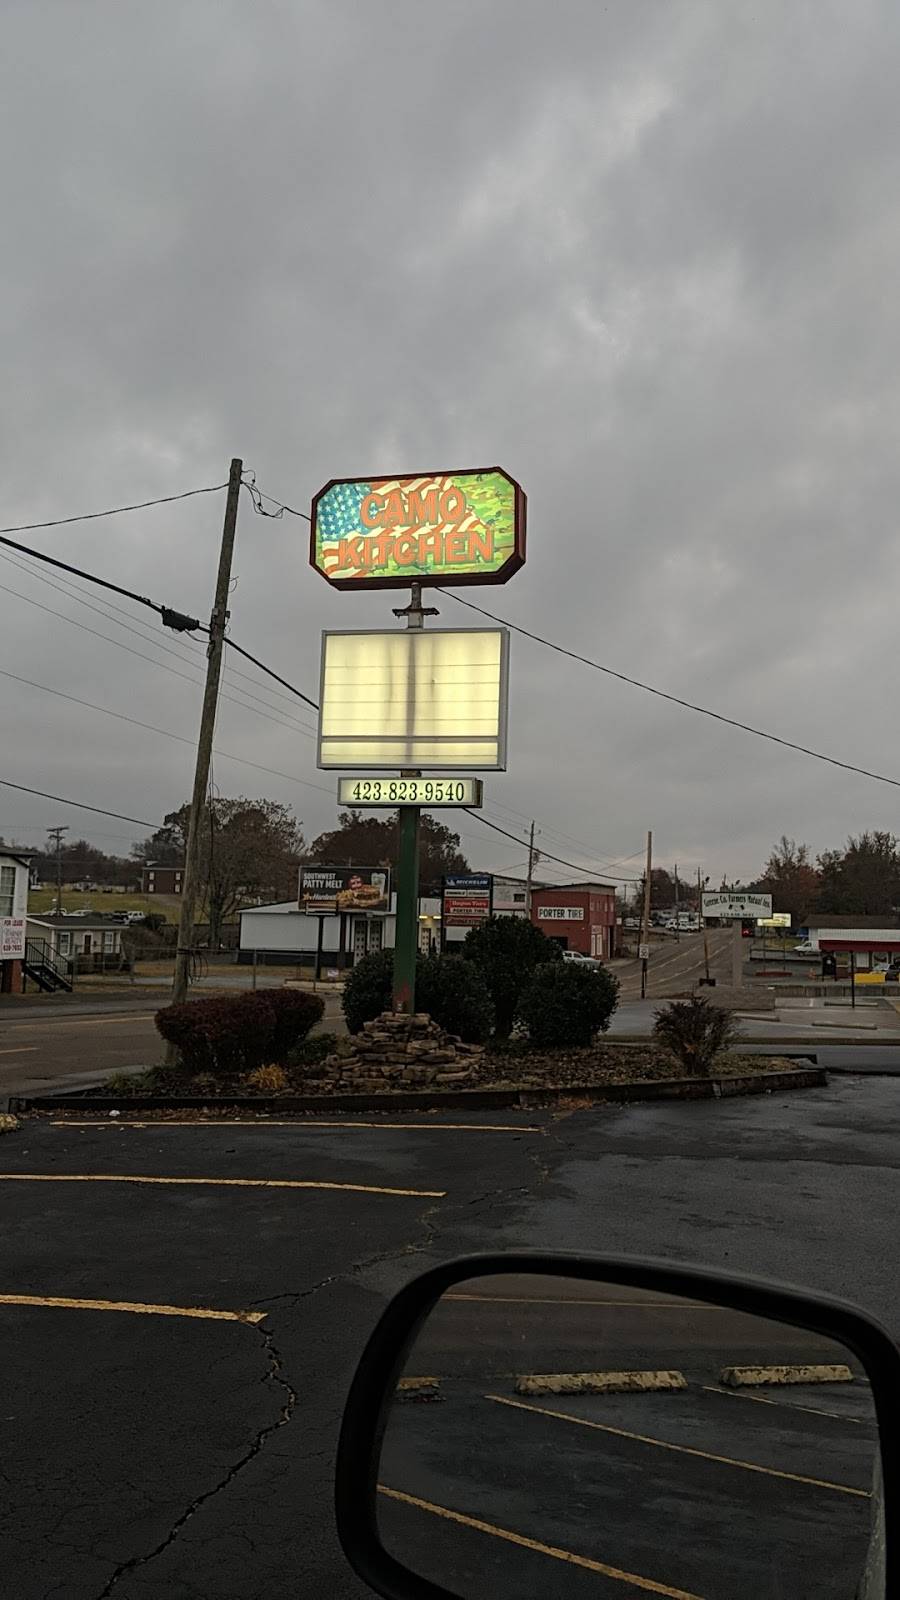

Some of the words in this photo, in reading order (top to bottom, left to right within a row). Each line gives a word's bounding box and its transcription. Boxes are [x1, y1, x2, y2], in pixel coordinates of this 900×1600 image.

[360, 486, 466, 528] CAMO
[338, 529, 495, 569] KITCHEN
[303, 872, 336, 880] SOUTHWEST
[303, 880, 324, 889] PATTY
[325, 880, 343, 889] MELT
[539, 908, 565, 918] PORTER
[568, 909, 583, 919] TIRE
